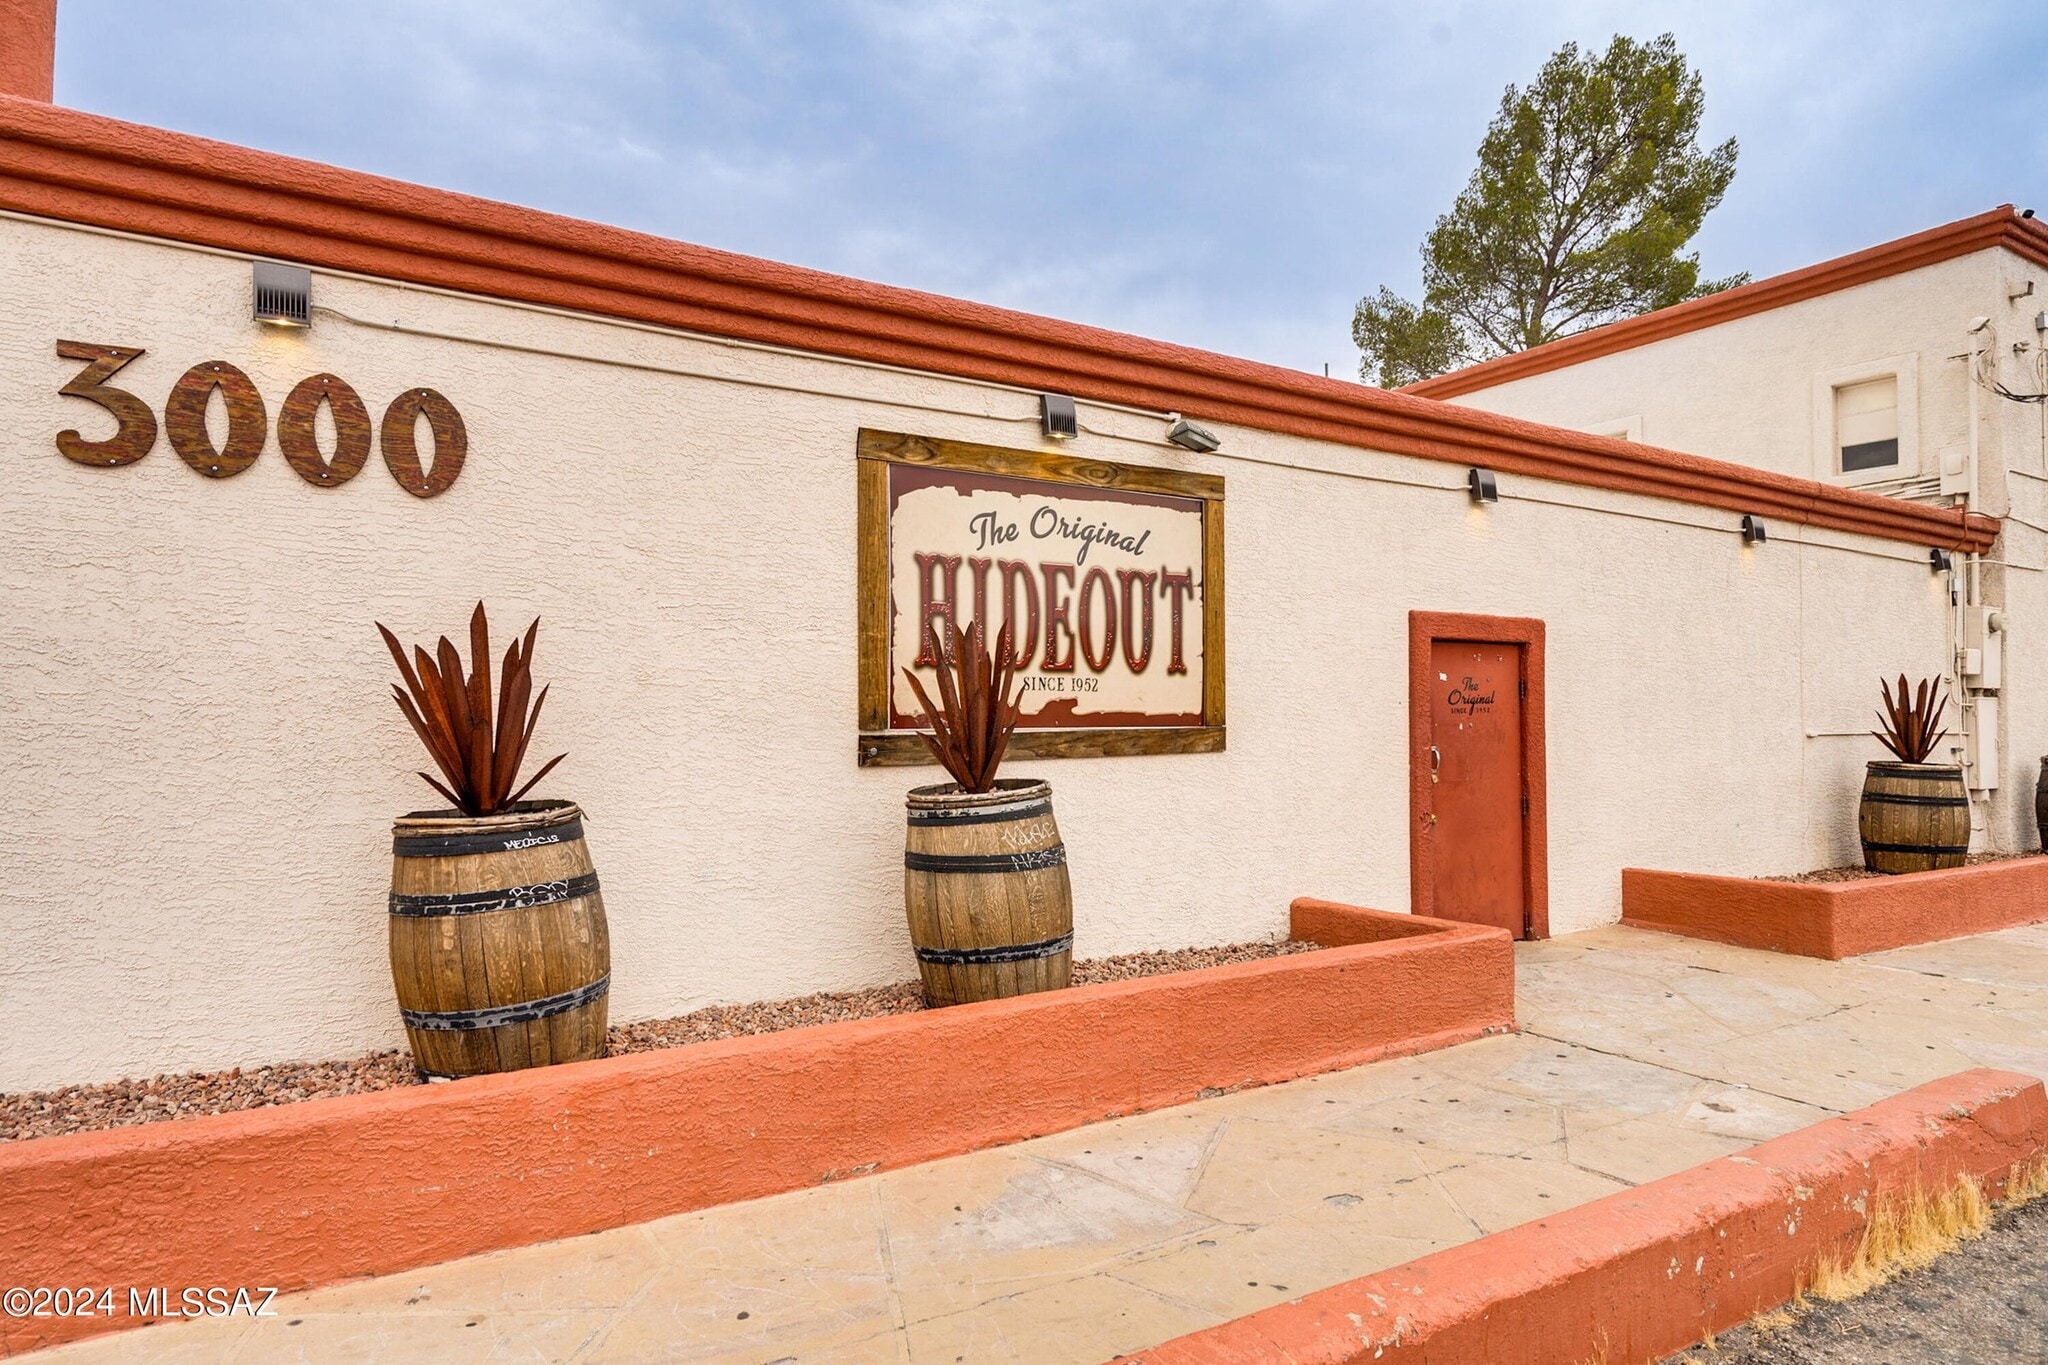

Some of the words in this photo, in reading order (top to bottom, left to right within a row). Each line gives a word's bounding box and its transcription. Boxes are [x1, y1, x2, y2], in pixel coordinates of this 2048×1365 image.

[56, 338, 468, 498] 3000
[969, 511, 1018, 550] The
[1030, 505, 1151, 566] Original
[914, 552, 1194, 674] HIDEOUT
[1023, 676, 1065, 692] SINCE
[1071, 677, 1099, 692] 1952
[1448, 689, 1495, 716] Original
[1462, 677, 1479, 691] The
